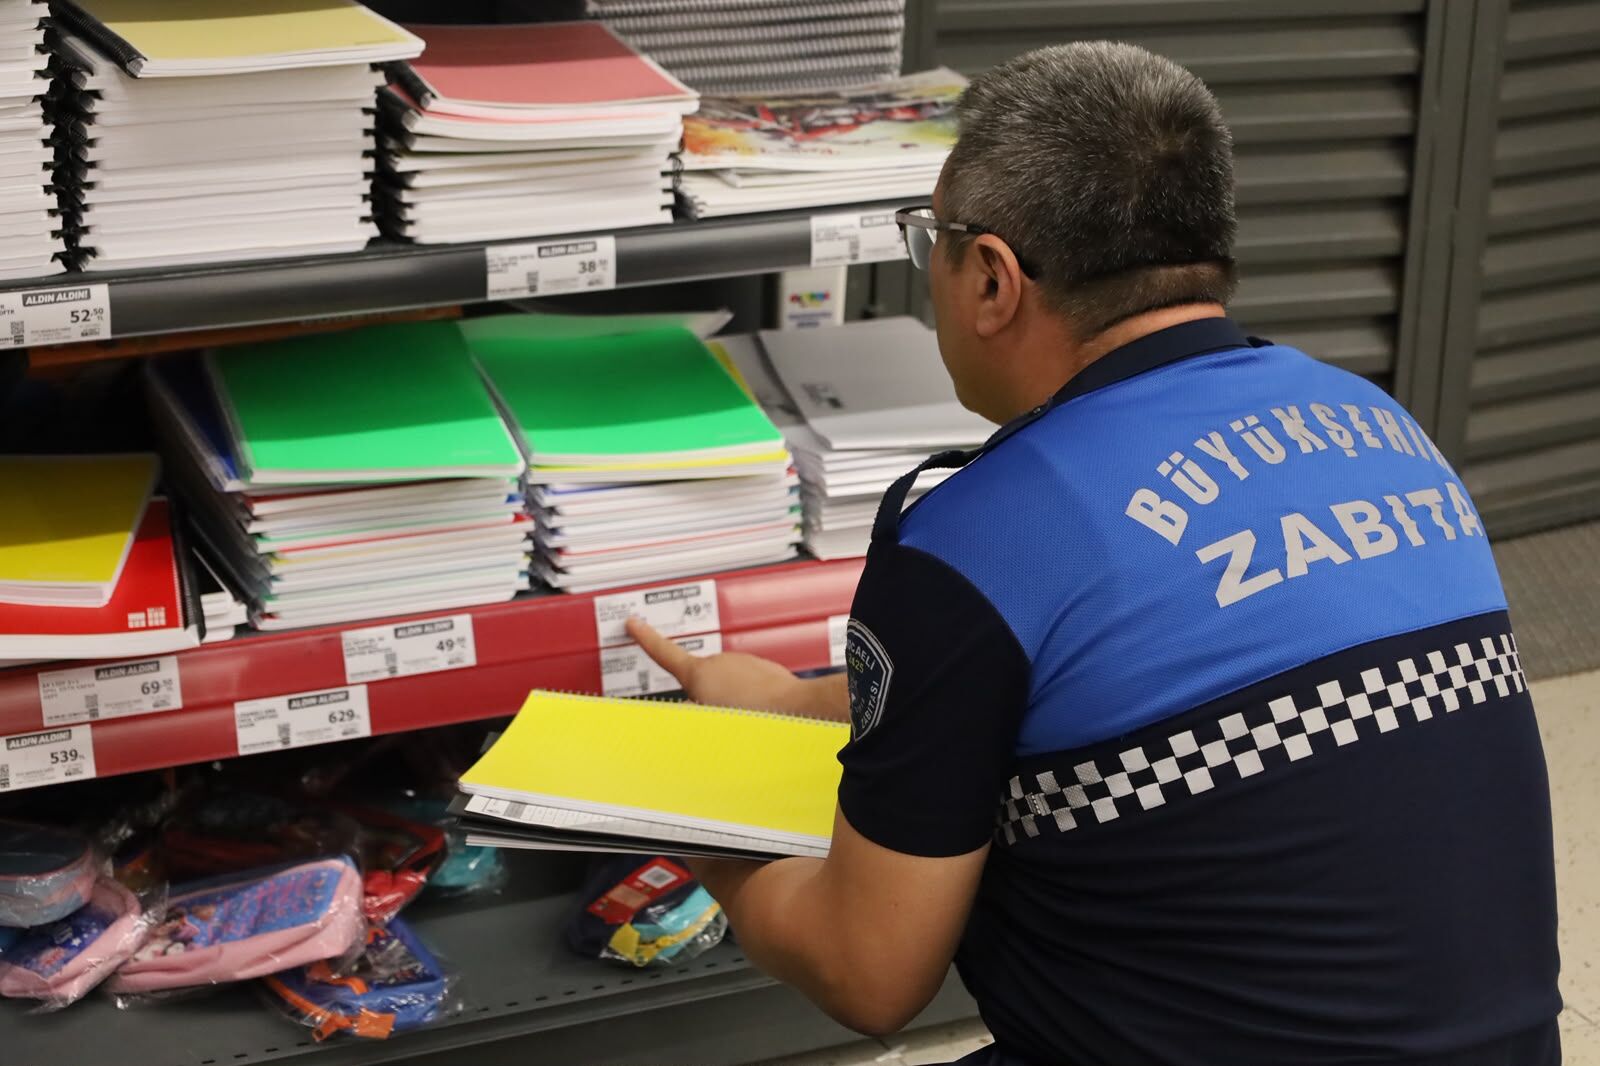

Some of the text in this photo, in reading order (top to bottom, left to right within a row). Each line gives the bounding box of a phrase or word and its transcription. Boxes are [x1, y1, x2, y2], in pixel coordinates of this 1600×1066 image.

[25, 294, 55, 306] ALDIN
[1195, 481, 1483, 608] ZABITA
[328, 709, 355, 723] 629
[50, 749, 78, 764] 539
